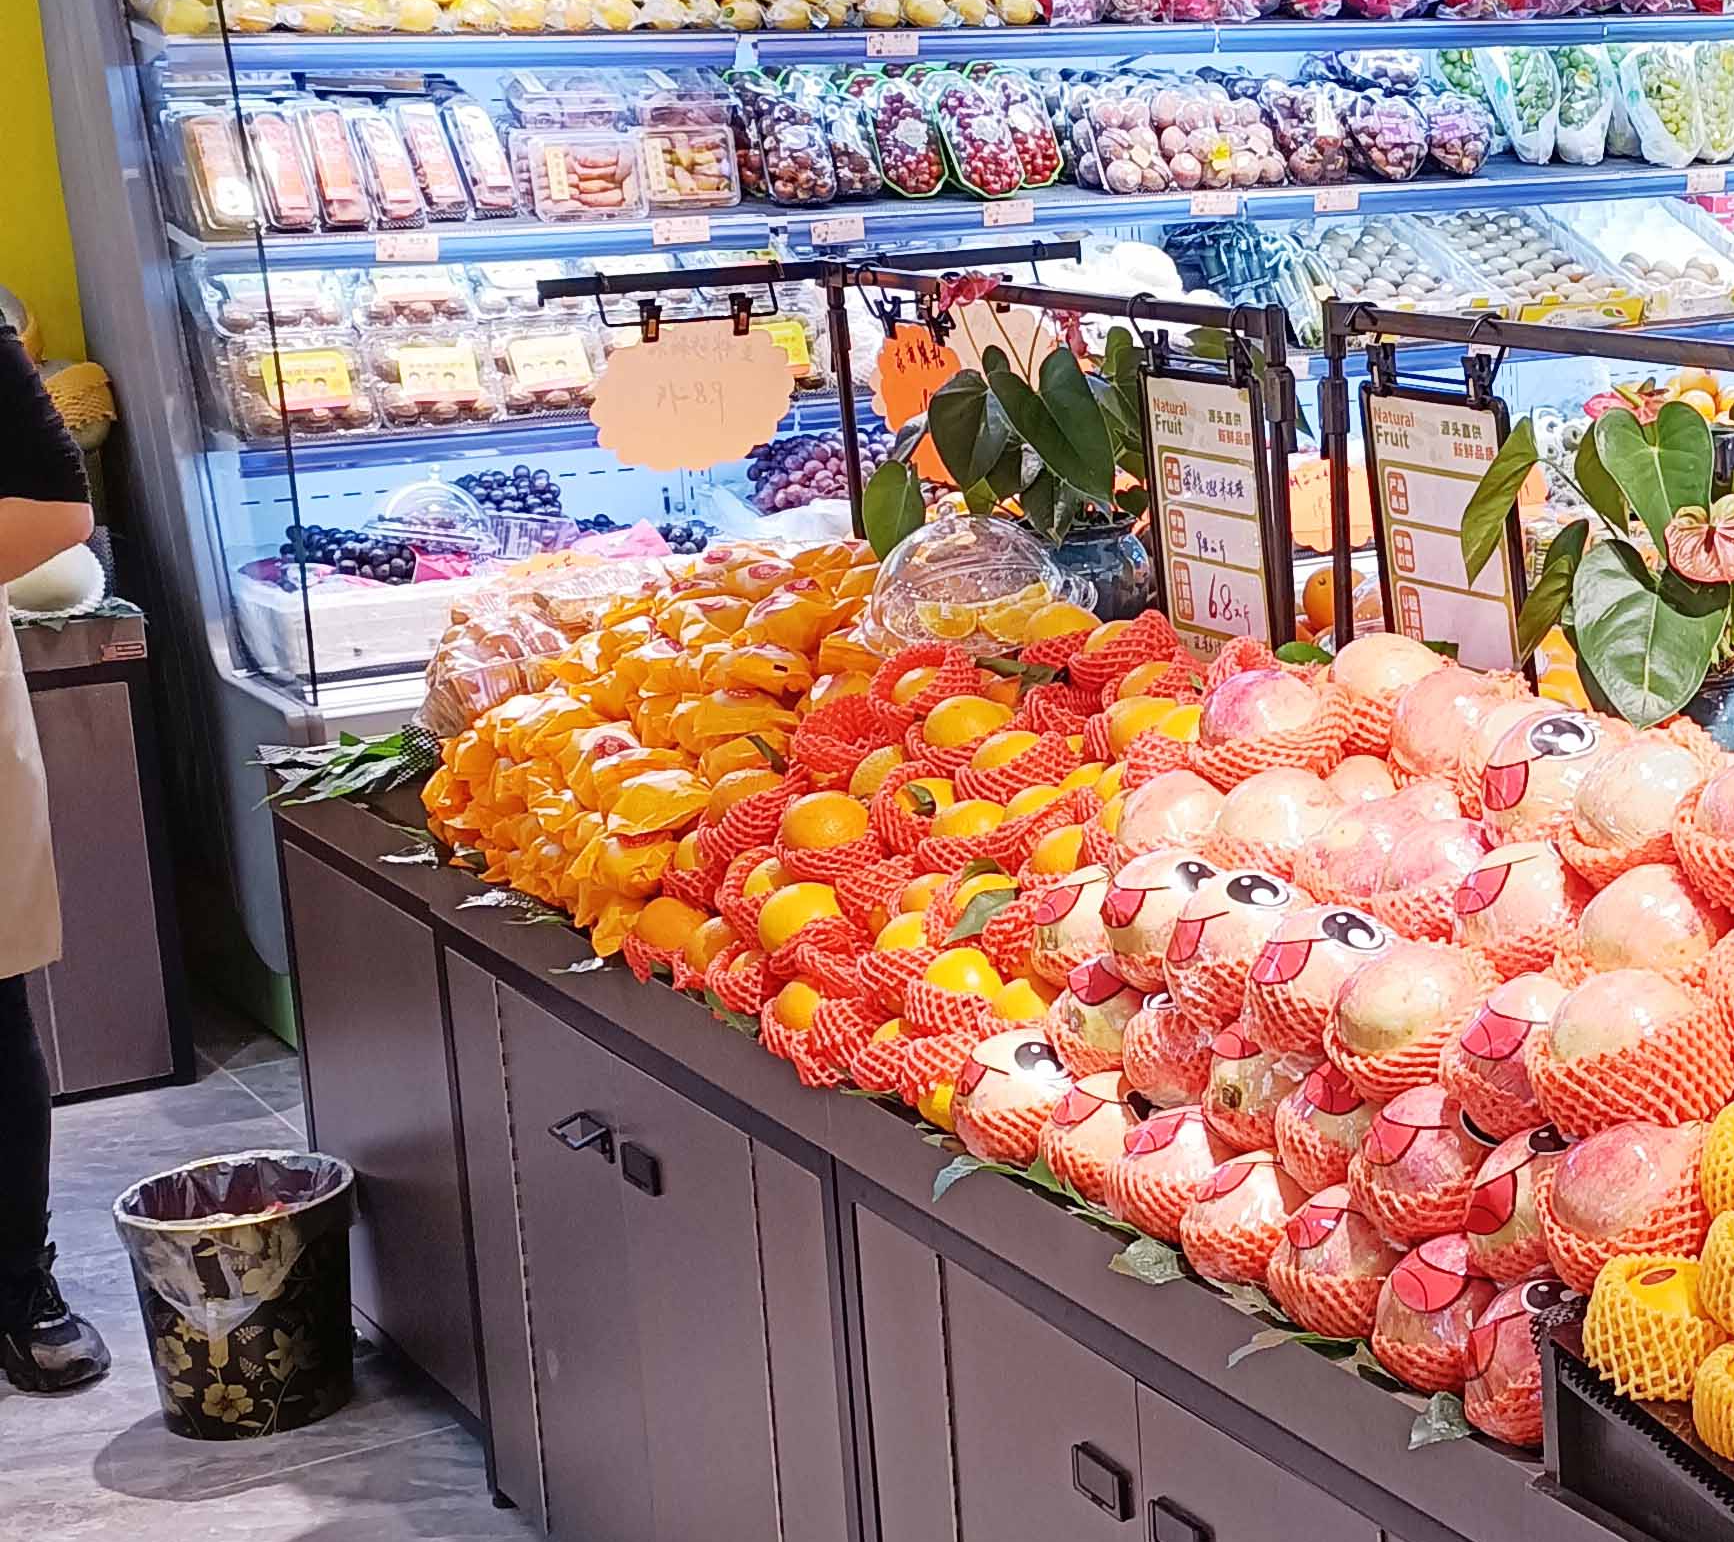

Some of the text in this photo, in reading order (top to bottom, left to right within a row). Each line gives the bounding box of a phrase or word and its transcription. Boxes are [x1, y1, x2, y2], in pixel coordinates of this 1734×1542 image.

[1153, 396, 1188, 416] Natural
[1373, 405, 1415, 428] Natural
[1155, 413, 1183, 435] Fruit
[1375, 425, 1410, 450] Fruit
